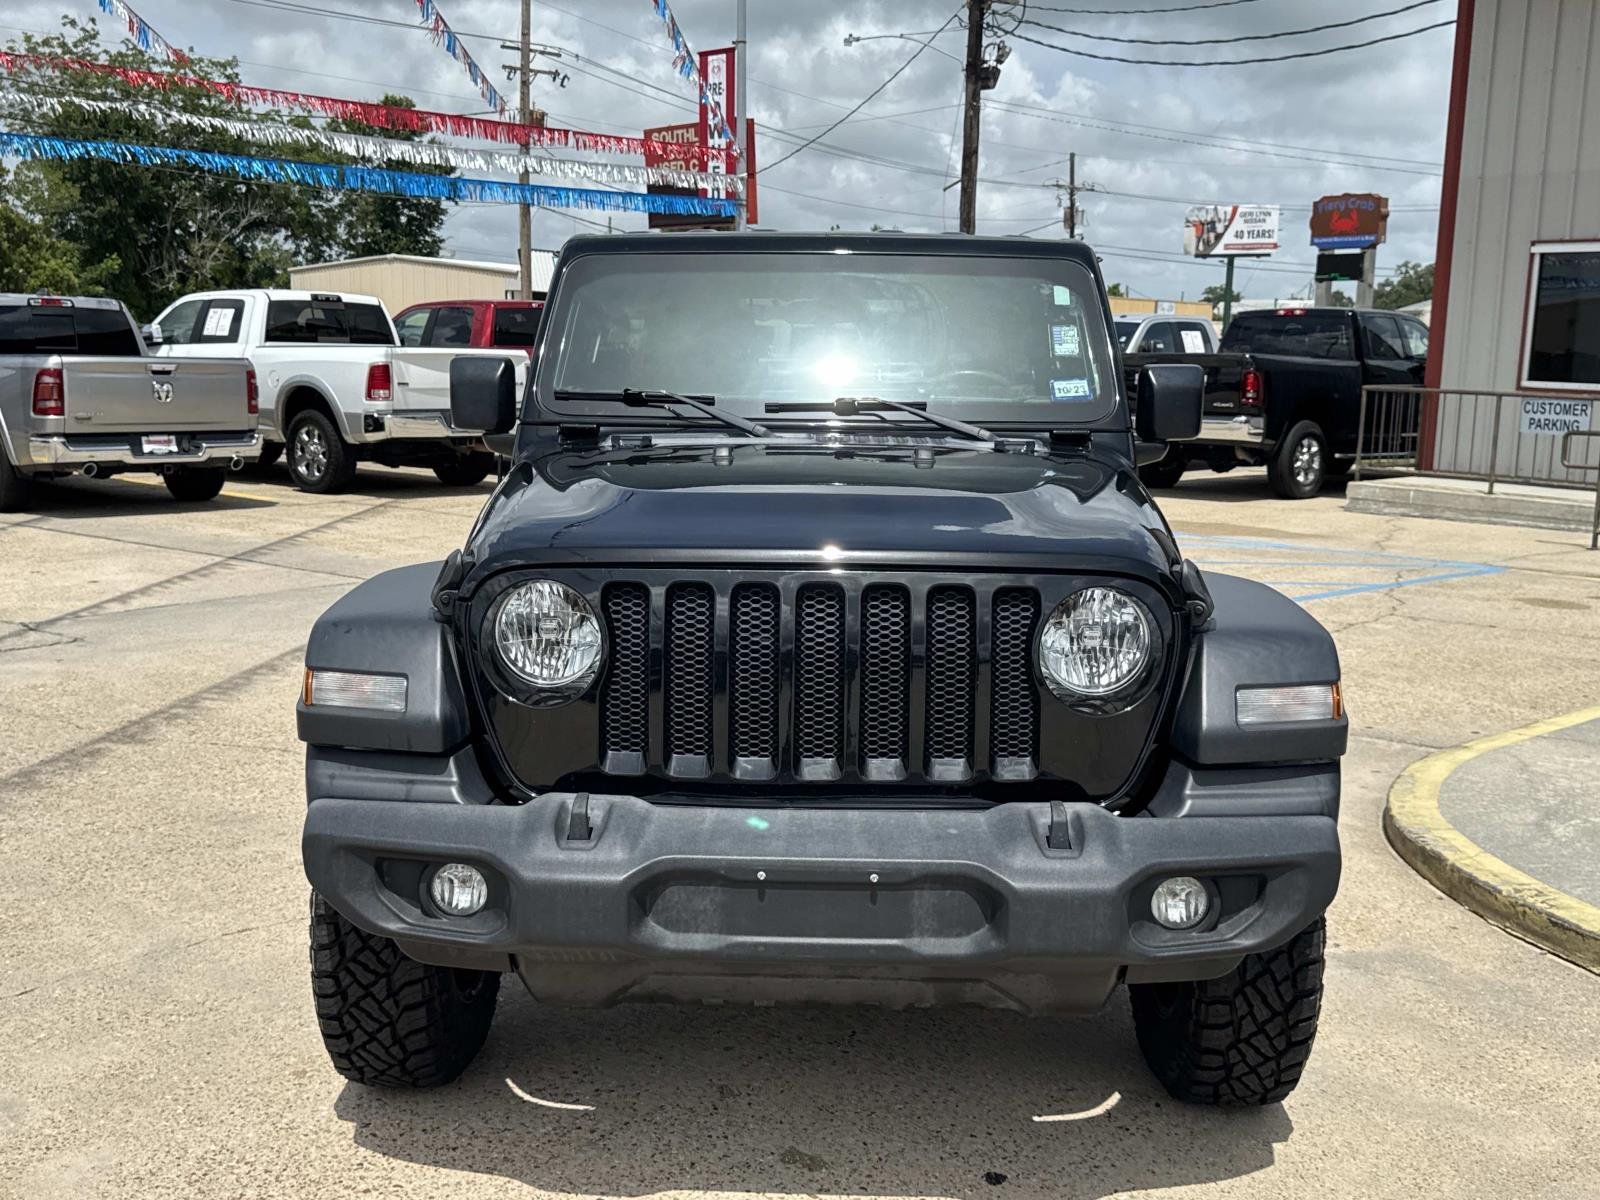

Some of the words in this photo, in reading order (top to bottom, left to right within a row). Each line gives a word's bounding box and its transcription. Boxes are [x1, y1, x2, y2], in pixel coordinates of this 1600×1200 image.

[1347, 198, 1375, 211] Crab
[1234, 229, 1244, 239] 40
[1247, 229, 1275, 239] YEARS!
[1523, 401, 1588, 416] CUSTOMER
[1528, 417, 1581, 432] PARKING
